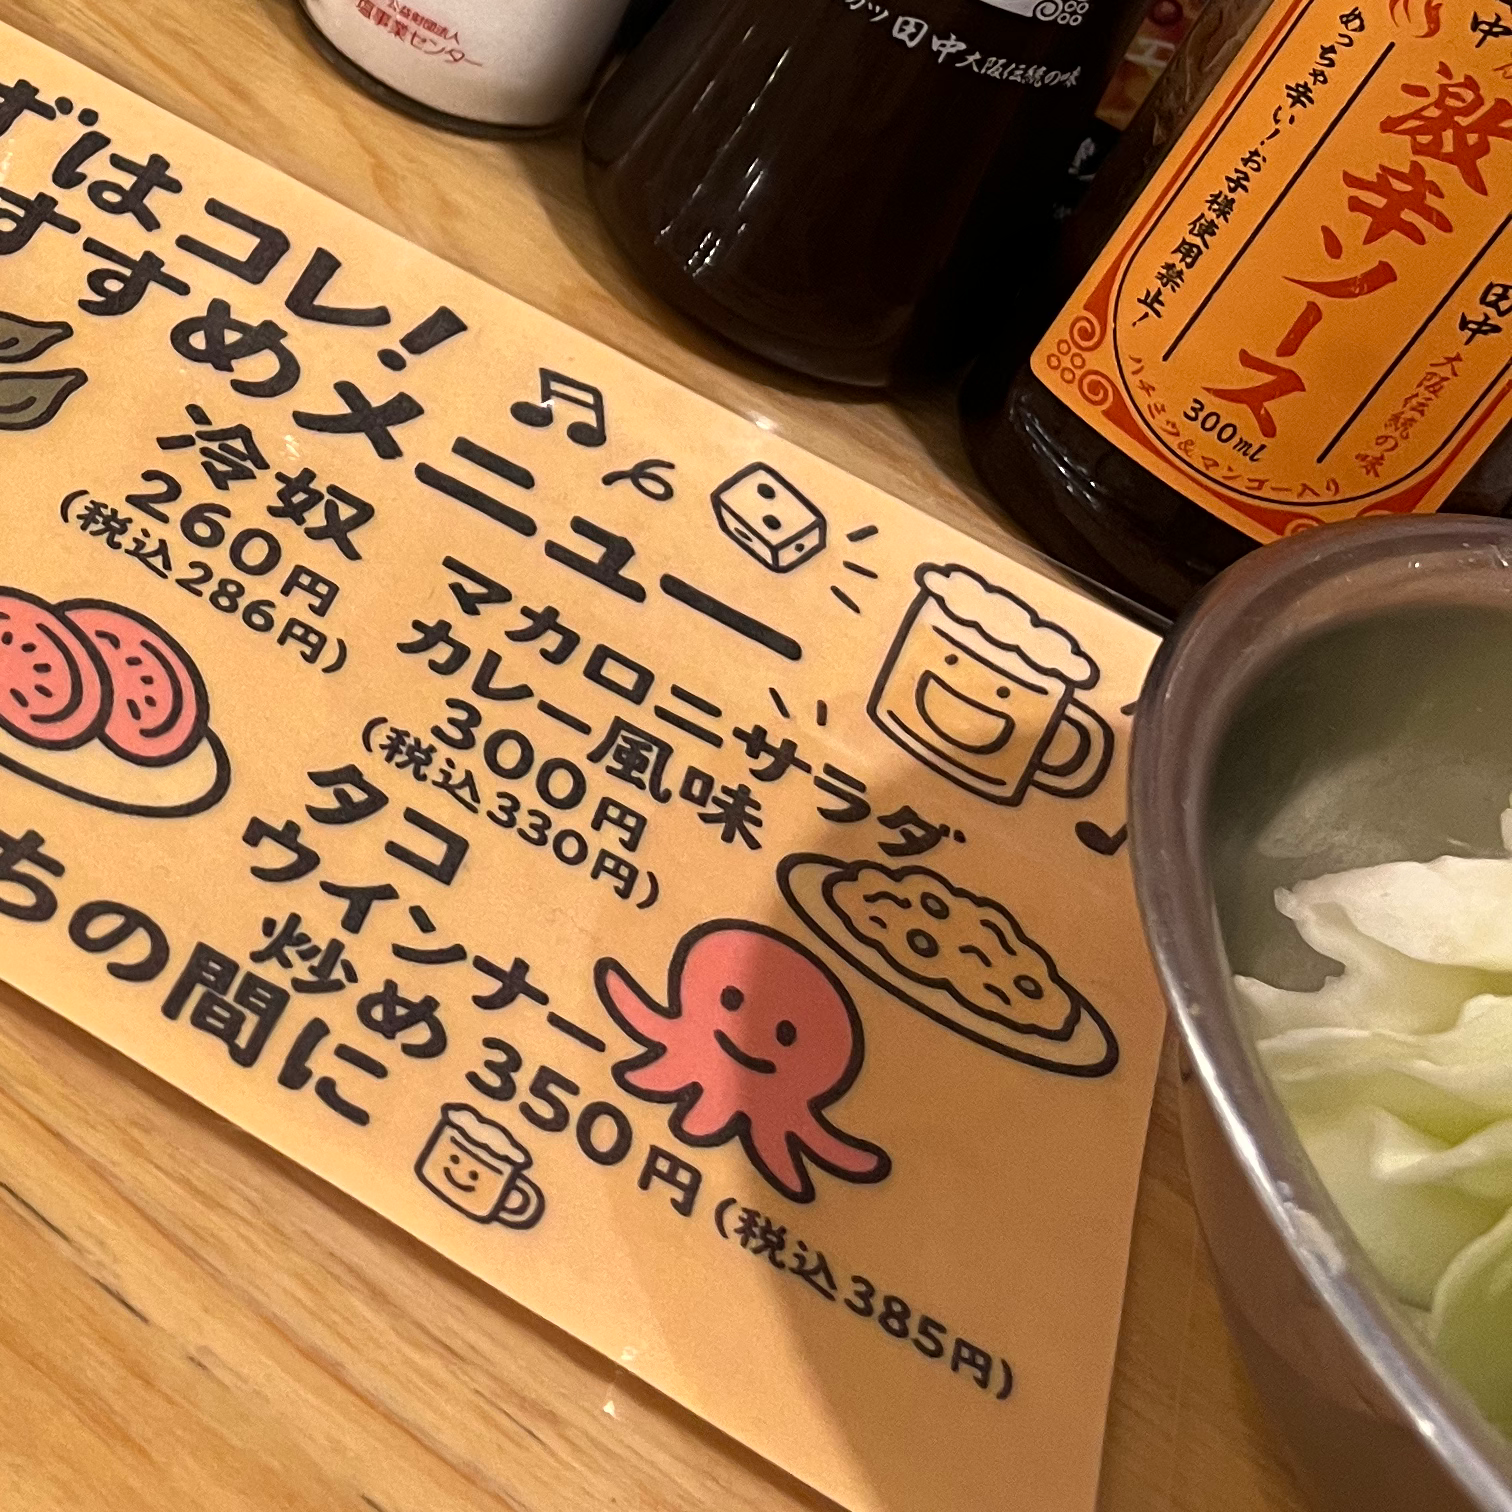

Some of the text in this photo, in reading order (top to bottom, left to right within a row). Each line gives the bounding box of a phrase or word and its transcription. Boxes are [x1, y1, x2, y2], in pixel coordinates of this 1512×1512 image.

[1132, 7, 1365, 327] めっちゃ辛い!お子様使用禁止!
[1201, 61, 1512, 438] 激辛ソース
[155, 403, 375, 561] 冷奴
[1183, 398, 1267, 462] 300ml
[59, 489, 348, 673] (税込286円)
[126, 469, 340, 618] 260円
[395, 619, 763, 851] カレー風味
[429, 697, 648, 854] 300円
[442, 555, 966, 858] マカロニサラダ
[305, 763, 470, 886] タコ
[359, 715, 659, 909] (税込330円)
[242, 816, 606, 1053] ウインナー
[249, 913, 1013, 1401] 炒め 350円 (税込385円)
